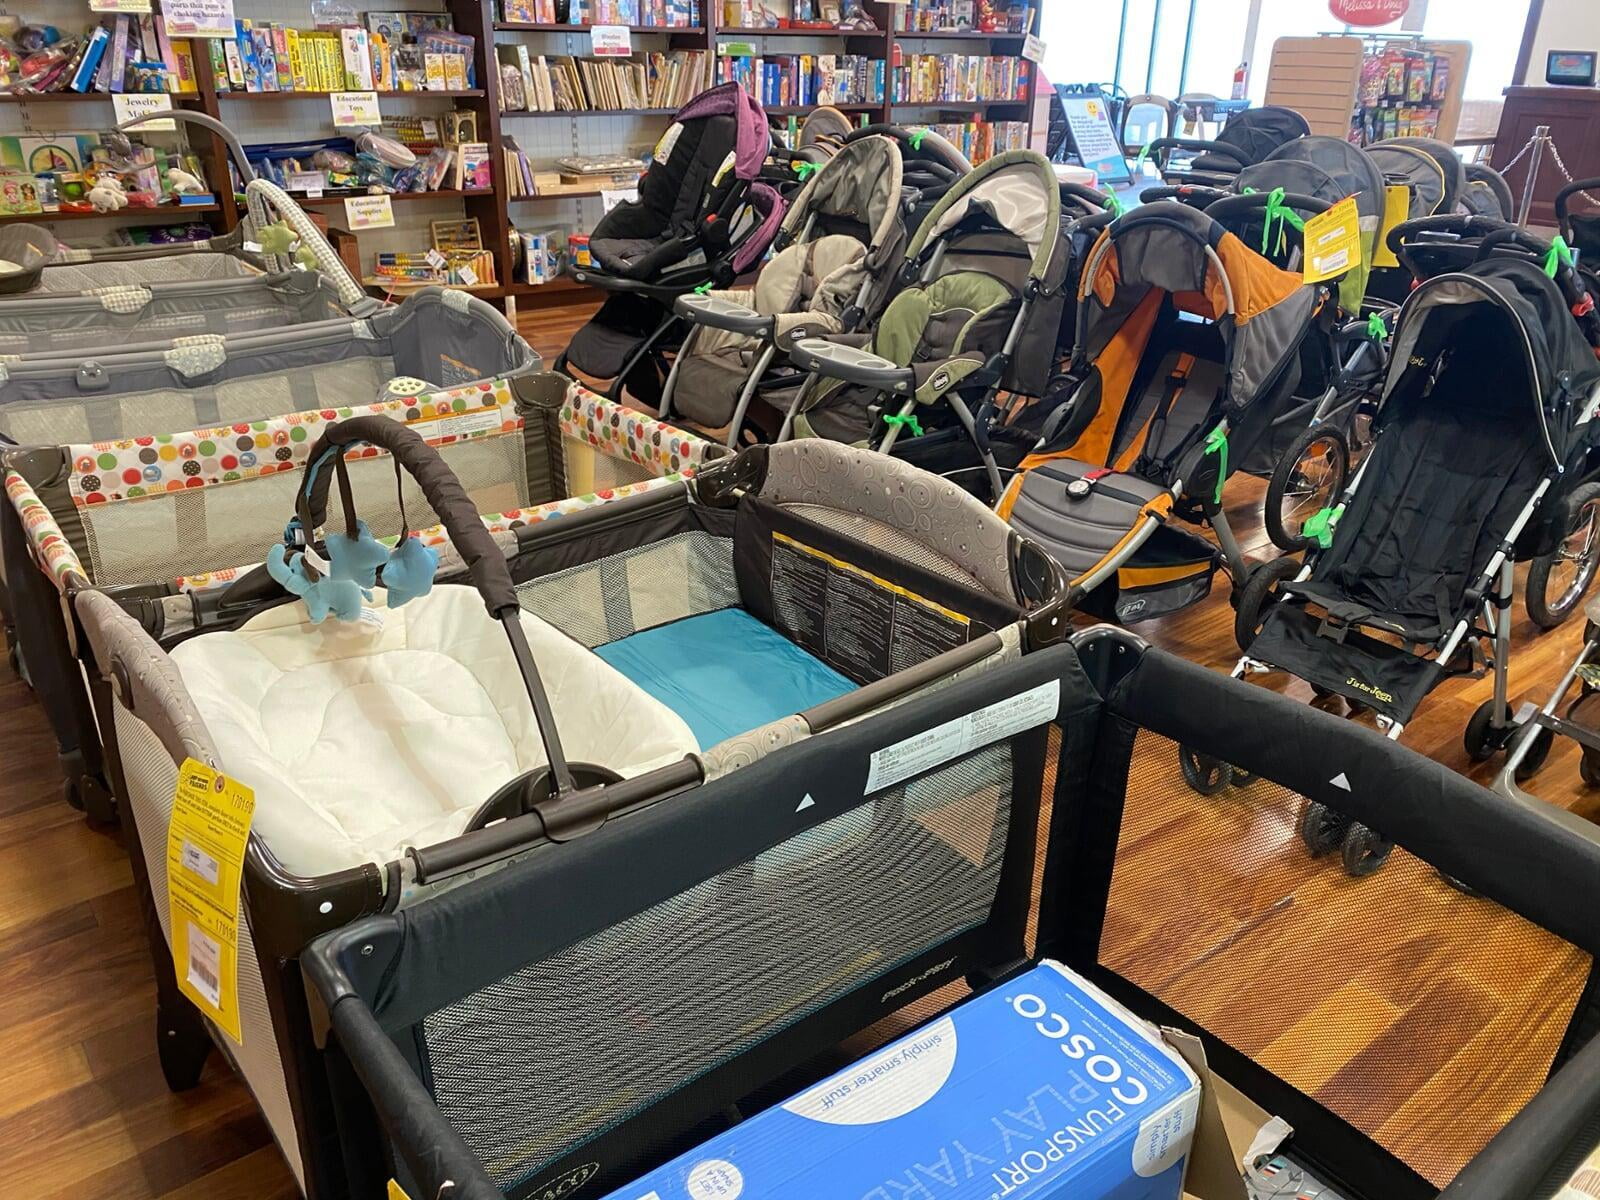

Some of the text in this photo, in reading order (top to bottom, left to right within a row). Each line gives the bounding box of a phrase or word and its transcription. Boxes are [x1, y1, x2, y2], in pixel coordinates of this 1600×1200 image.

[173, 10, 226, 18] choking hazard
[125, 98, 160, 107] Jewelry
[348, 104, 364, 112] Toys
[350, 198, 386, 207] Educational
[356, 208, 383, 217] Supplies
[1370, 685, 1393, 703] Jeep
[820, 1034, 943, 1112] simply smarter stuff
[991, 1068, 1100, 1154] PLAY
[1173, 1108, 1183, 1134] stuff
[1146, 1123, 1162, 1161] simply
[1159, 1117, 1170, 1160] smarter
